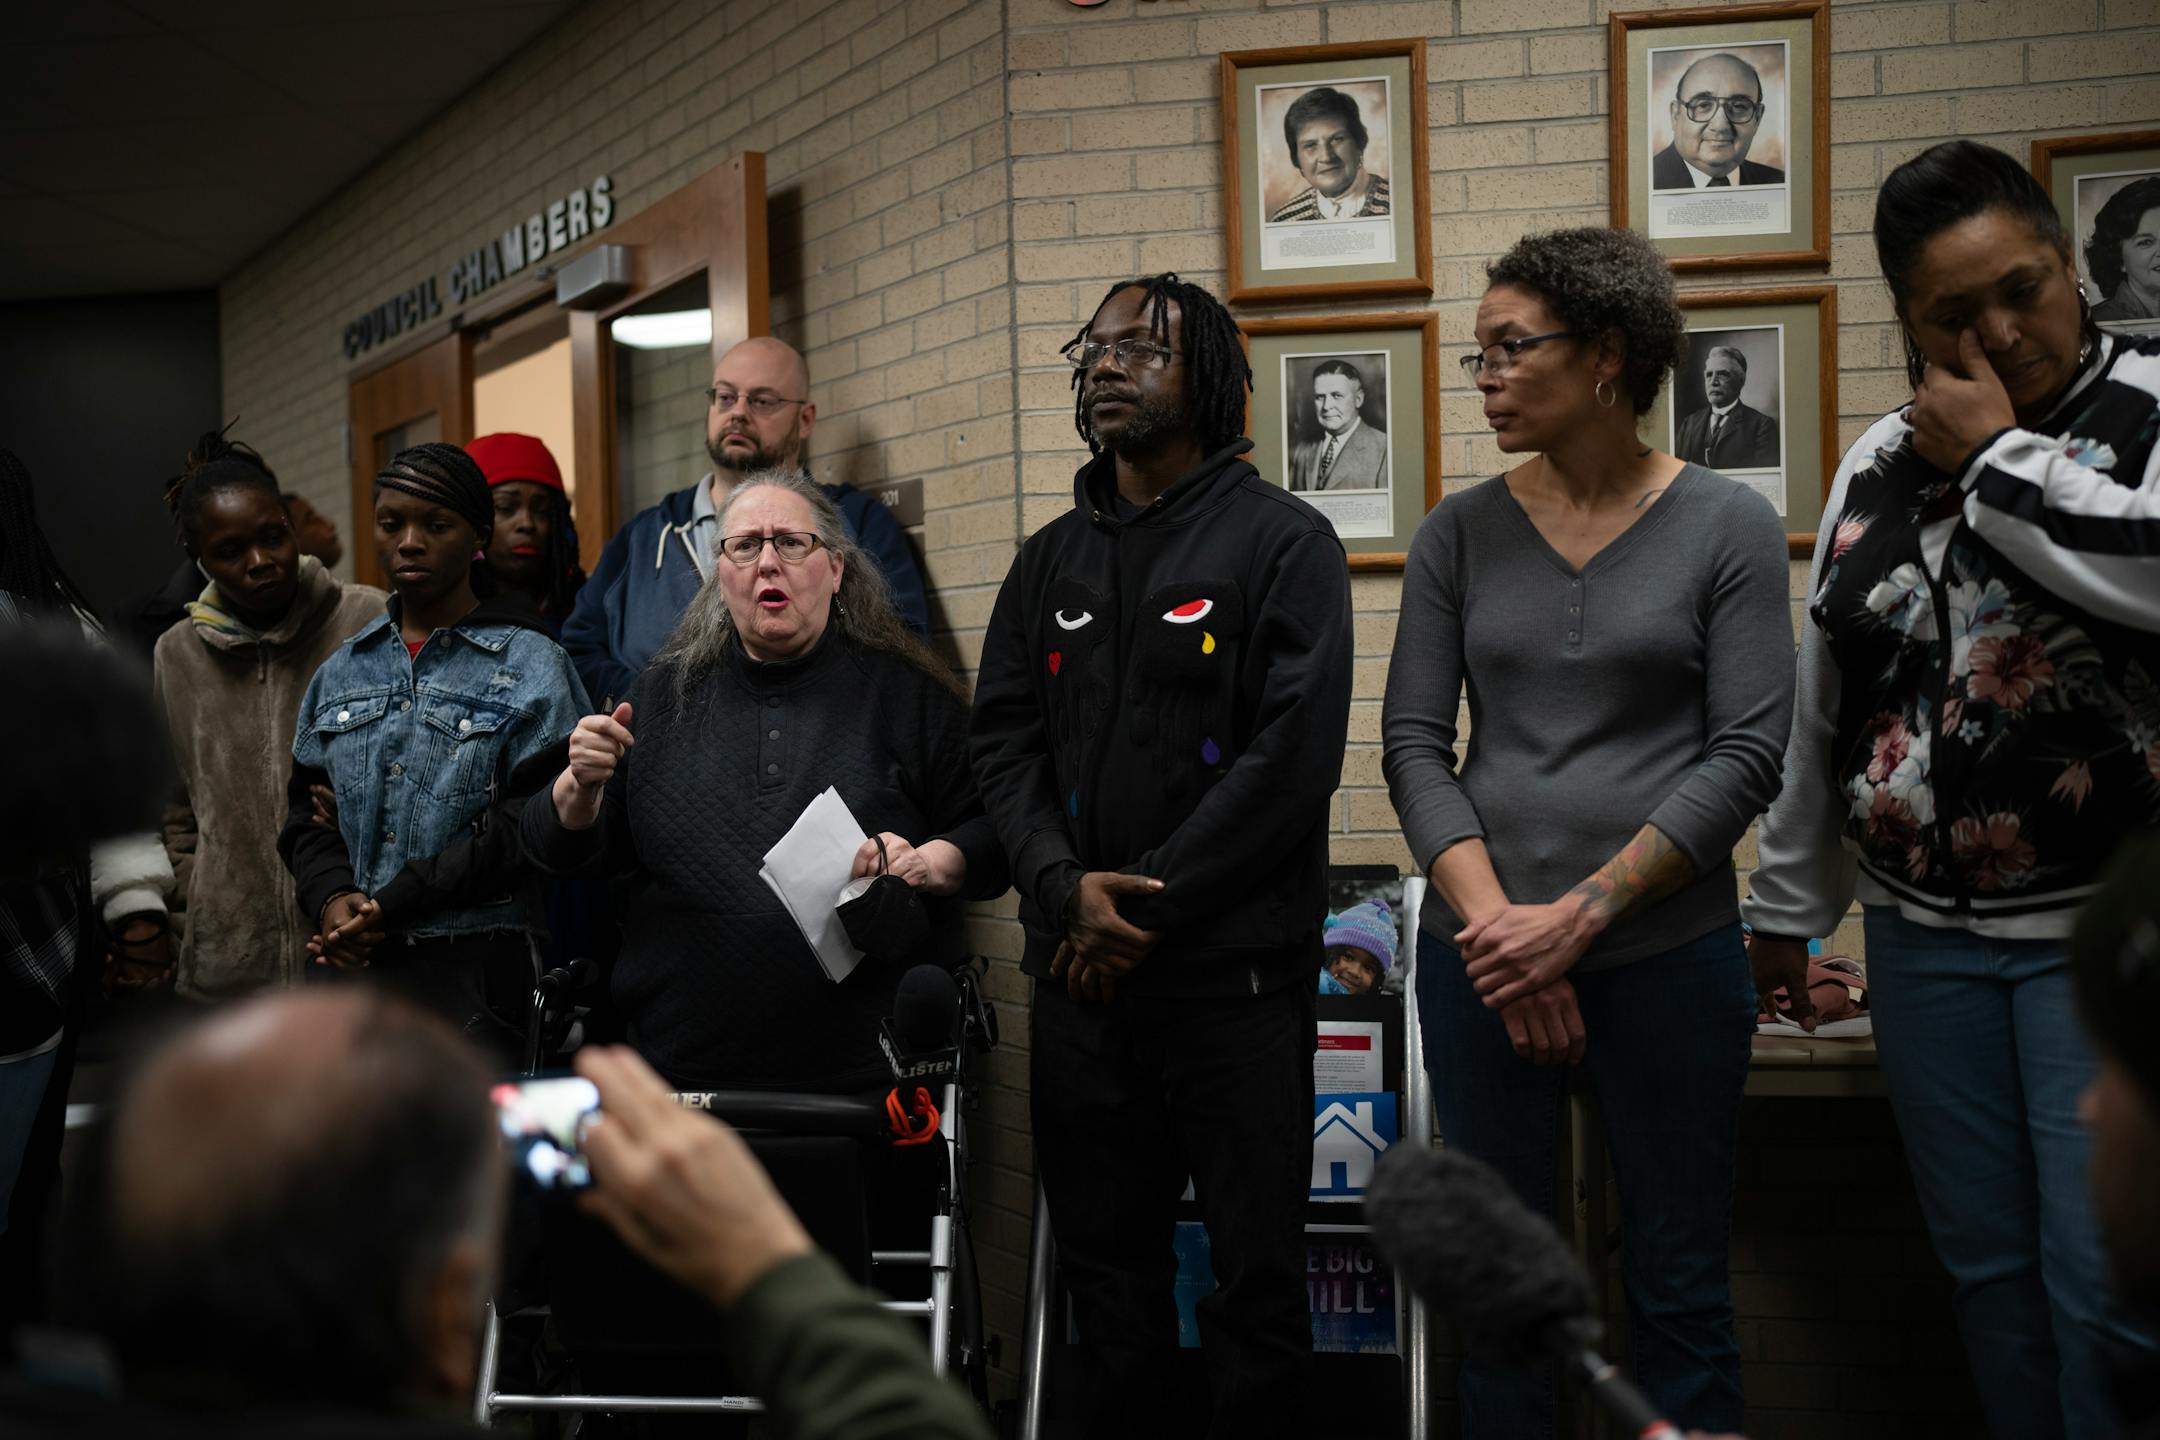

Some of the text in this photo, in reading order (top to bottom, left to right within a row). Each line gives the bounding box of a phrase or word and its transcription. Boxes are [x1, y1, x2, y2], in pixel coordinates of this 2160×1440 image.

[344, 175, 614, 358] COUNCIL CHAMBERS
[880, 489, 899, 506] 201
